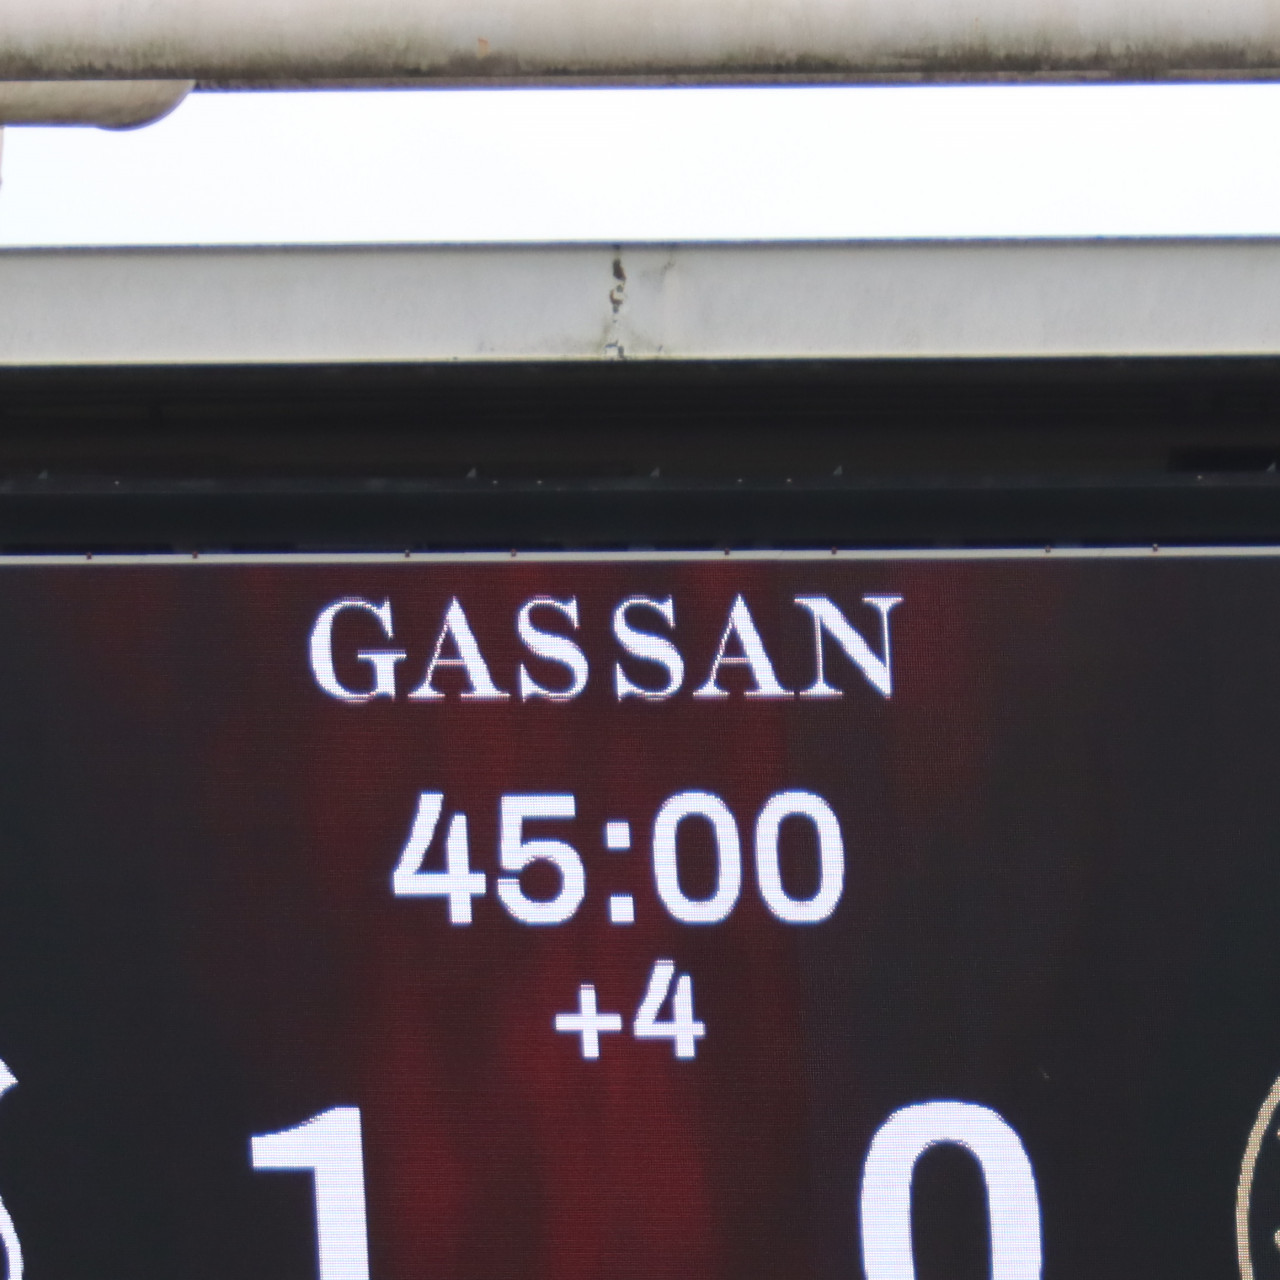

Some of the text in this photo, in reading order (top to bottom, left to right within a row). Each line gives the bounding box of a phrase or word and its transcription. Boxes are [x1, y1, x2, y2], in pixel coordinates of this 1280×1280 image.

[310, 594, 902, 704] GASSAN
[392, 790, 846, 926] 45:00
[555, 958, 707, 1059] +4
